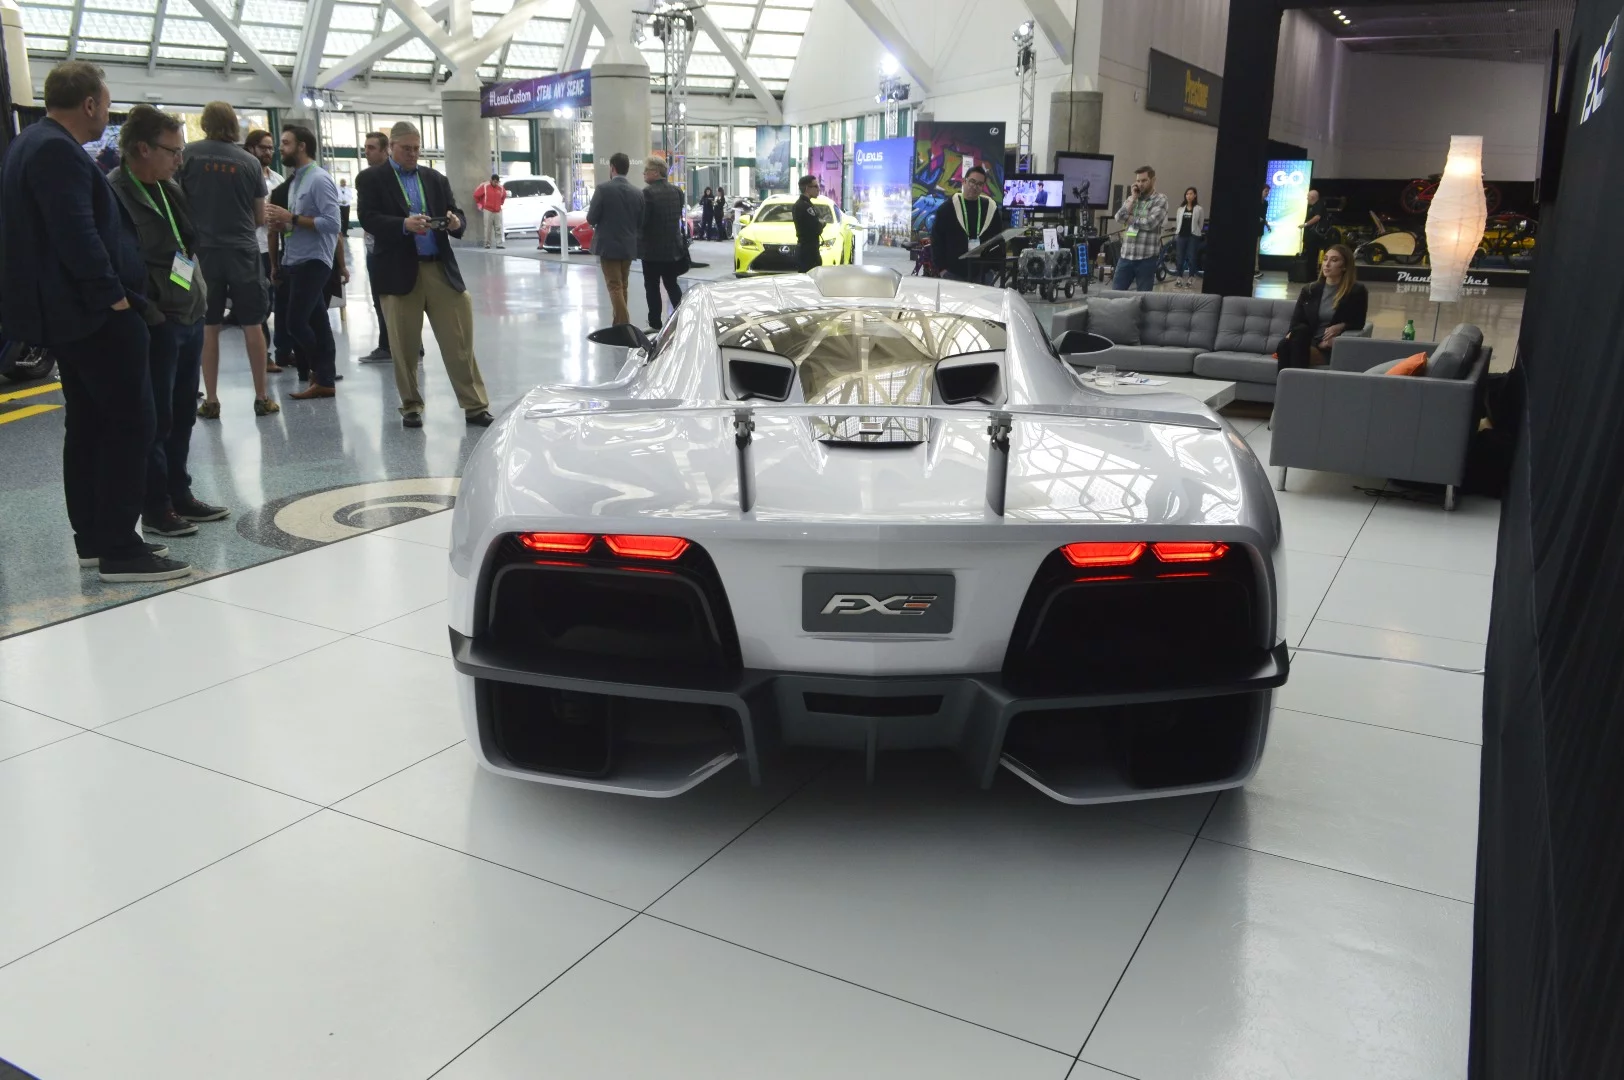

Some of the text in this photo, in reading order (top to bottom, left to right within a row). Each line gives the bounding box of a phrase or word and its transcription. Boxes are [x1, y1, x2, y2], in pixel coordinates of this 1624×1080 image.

[489, 87, 531, 107] #LexusCustom
[536, 79, 585, 102] STEAL ANY SCENE
[862, 152, 883, 162] LEXUS
[1272, 170, 1304, 186] GO
[1397, 271, 1489, 286] Phant ikes
[820, 594, 938, 616] FXE
